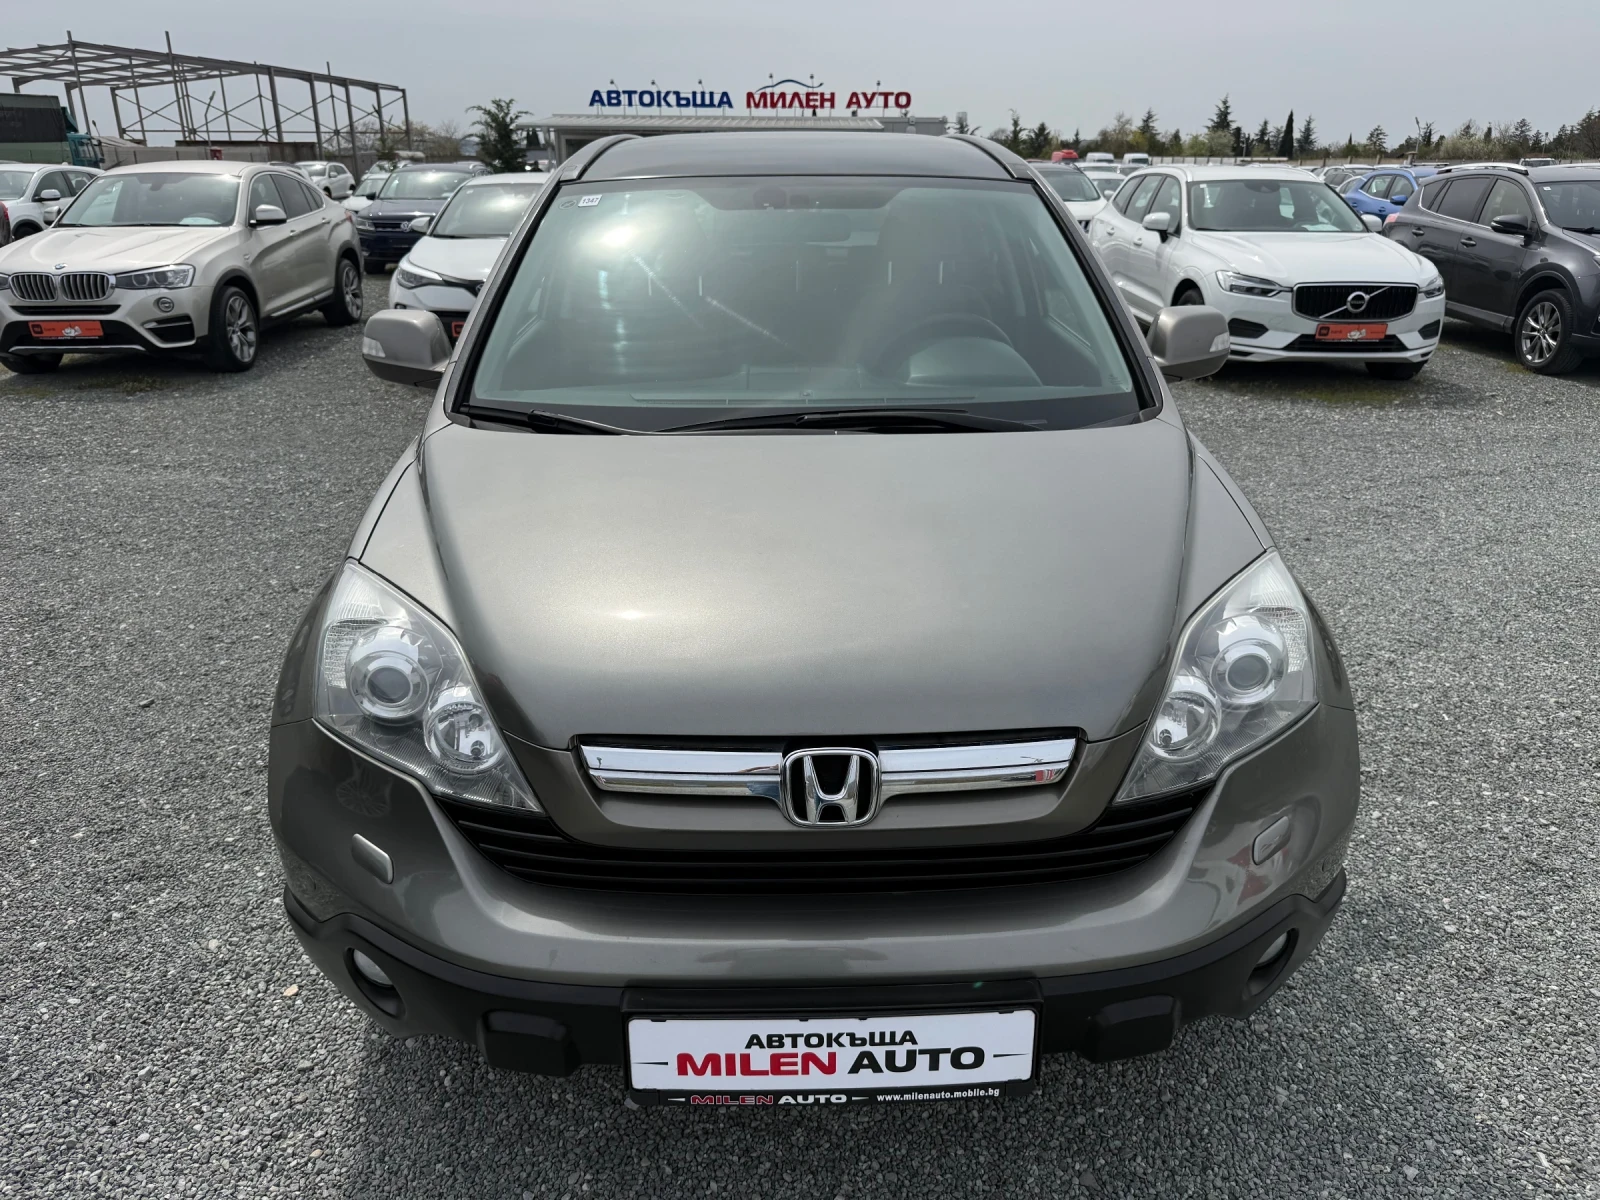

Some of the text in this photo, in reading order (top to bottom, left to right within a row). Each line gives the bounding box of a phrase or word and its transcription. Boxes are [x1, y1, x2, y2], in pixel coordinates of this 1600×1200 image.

[589, 90, 912, 109] АВТОКЪЩА МИЛЕН АУТО
[745, 1030, 918, 1049] АВТОКЪЩА
[676, 1046, 985, 1076] MILEN AUTO
[690, 1094, 847, 1105] MILEN AUTO
[876, 1088, 1000, 1102] www.milenauto.mobile.bg
